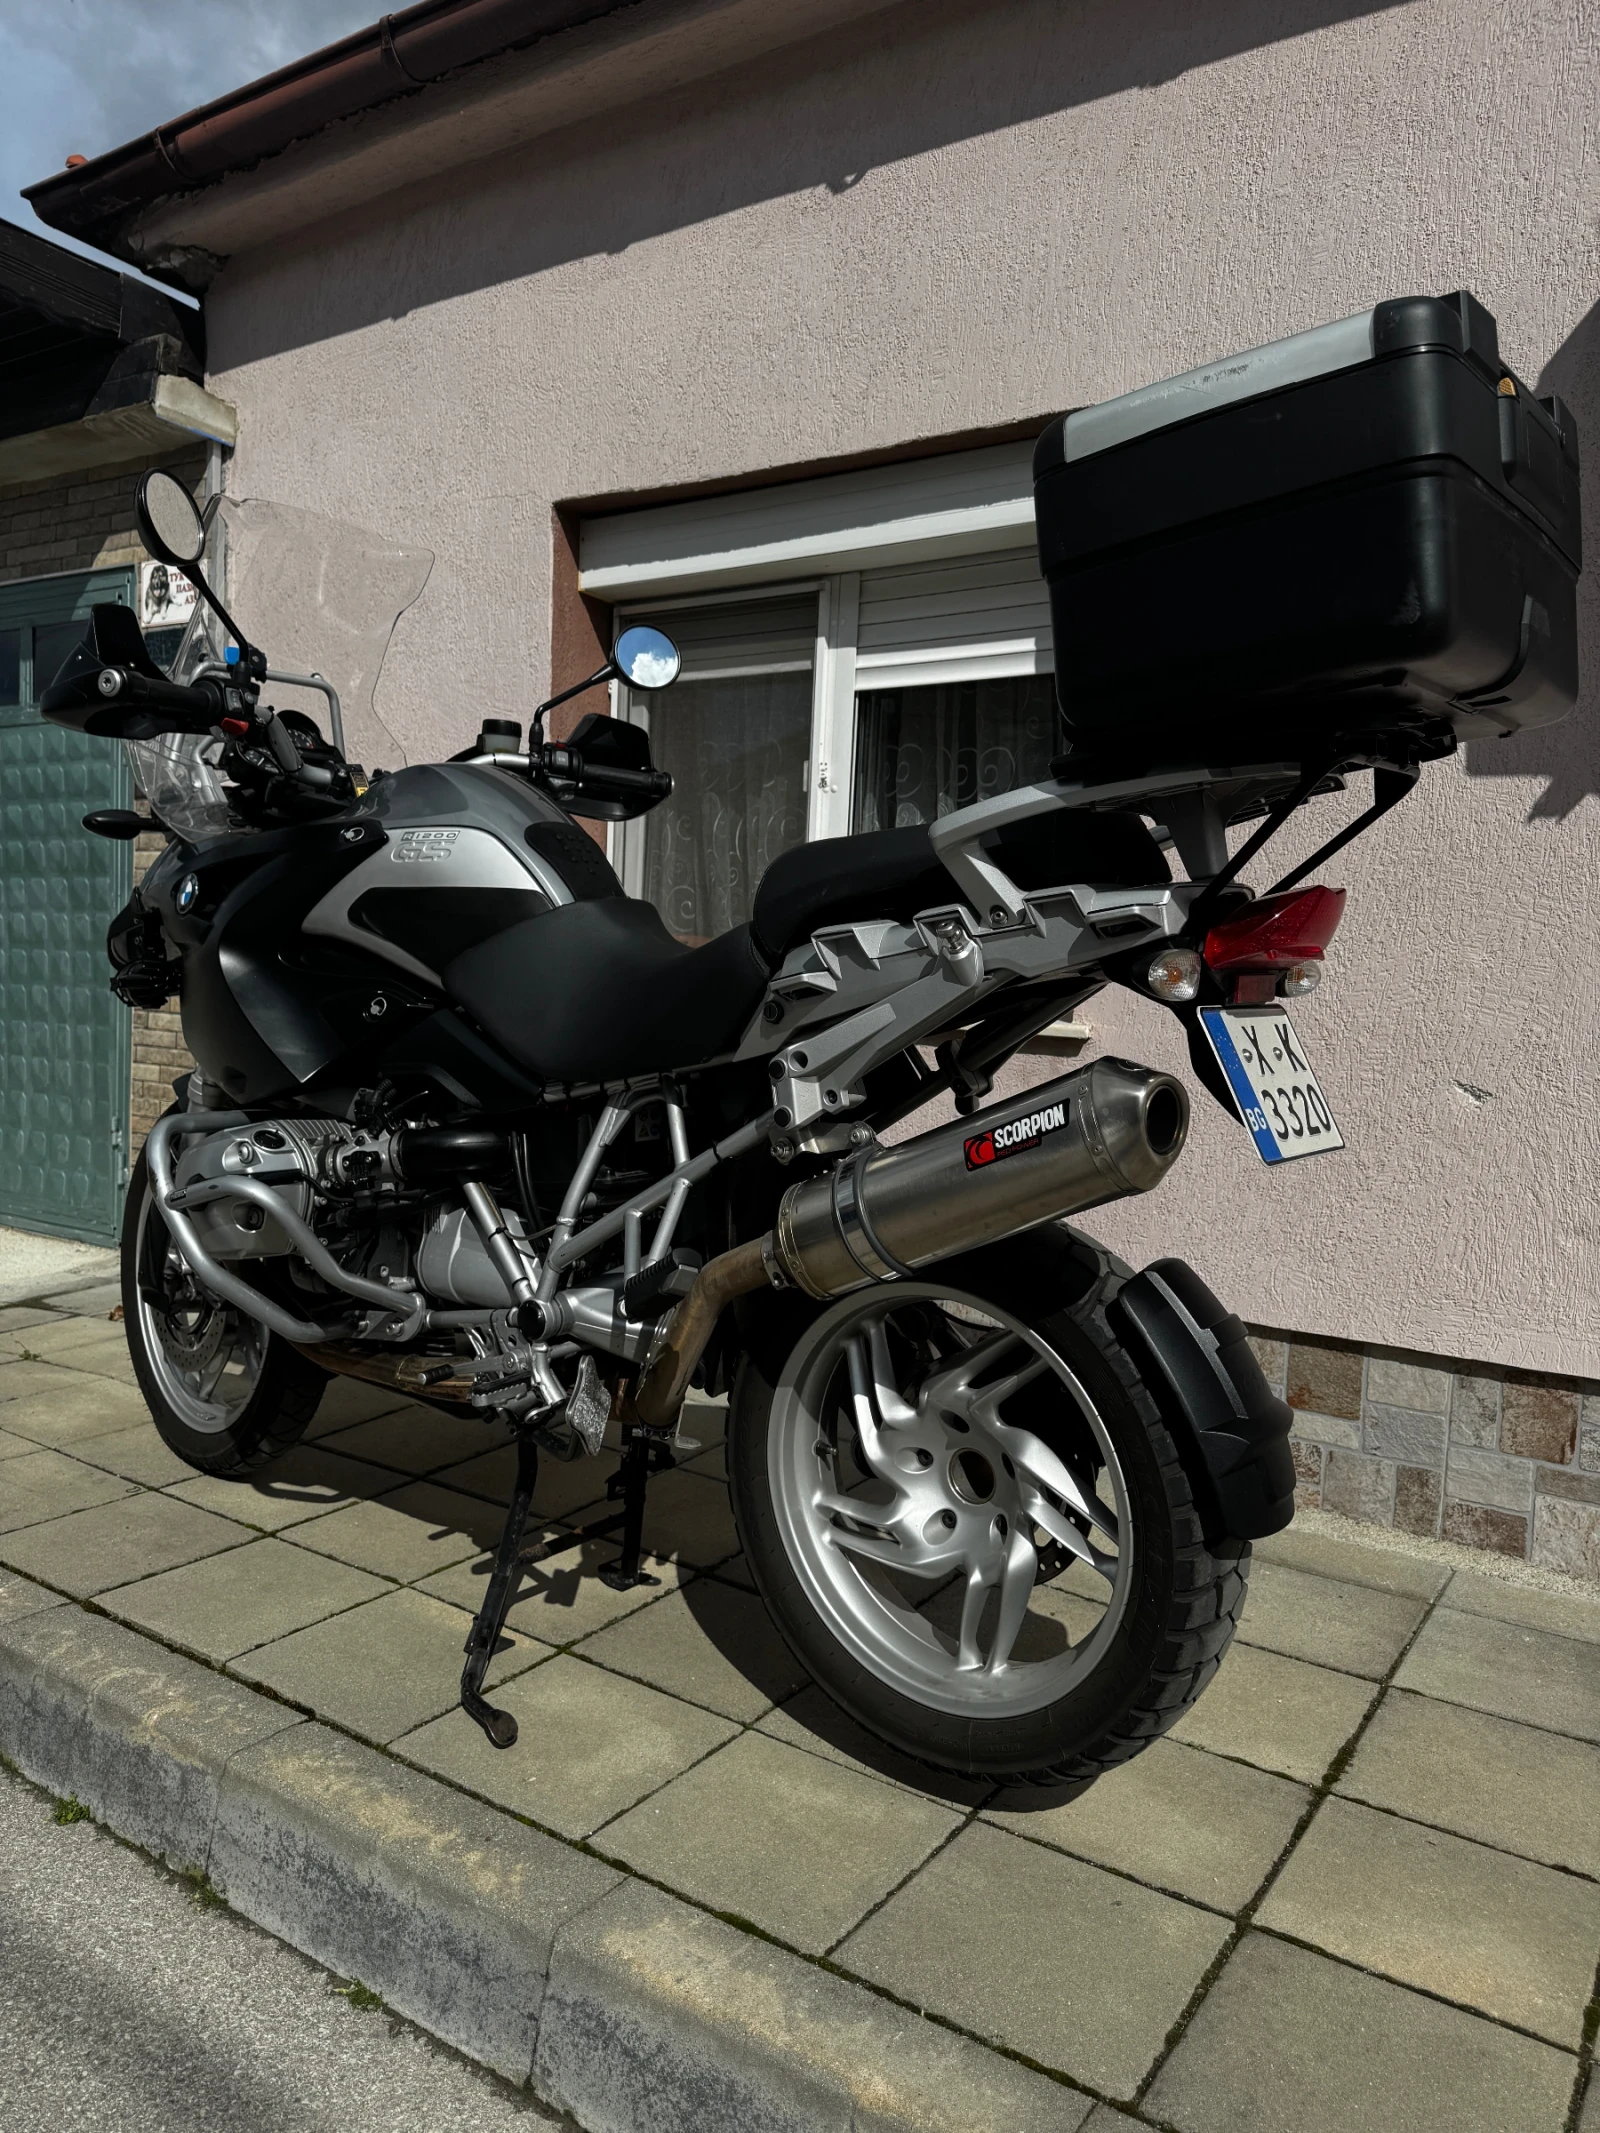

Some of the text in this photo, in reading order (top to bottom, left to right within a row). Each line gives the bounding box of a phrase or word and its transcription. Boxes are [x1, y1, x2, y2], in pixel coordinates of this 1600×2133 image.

[402, 832, 458, 840] R1200
[391, 841, 455, 863] GS
[1244, 1108, 1267, 1132] BG
[1261, 1083, 1331, 1140] 3320
[994, 1103, 1066, 1148] SCORPION
